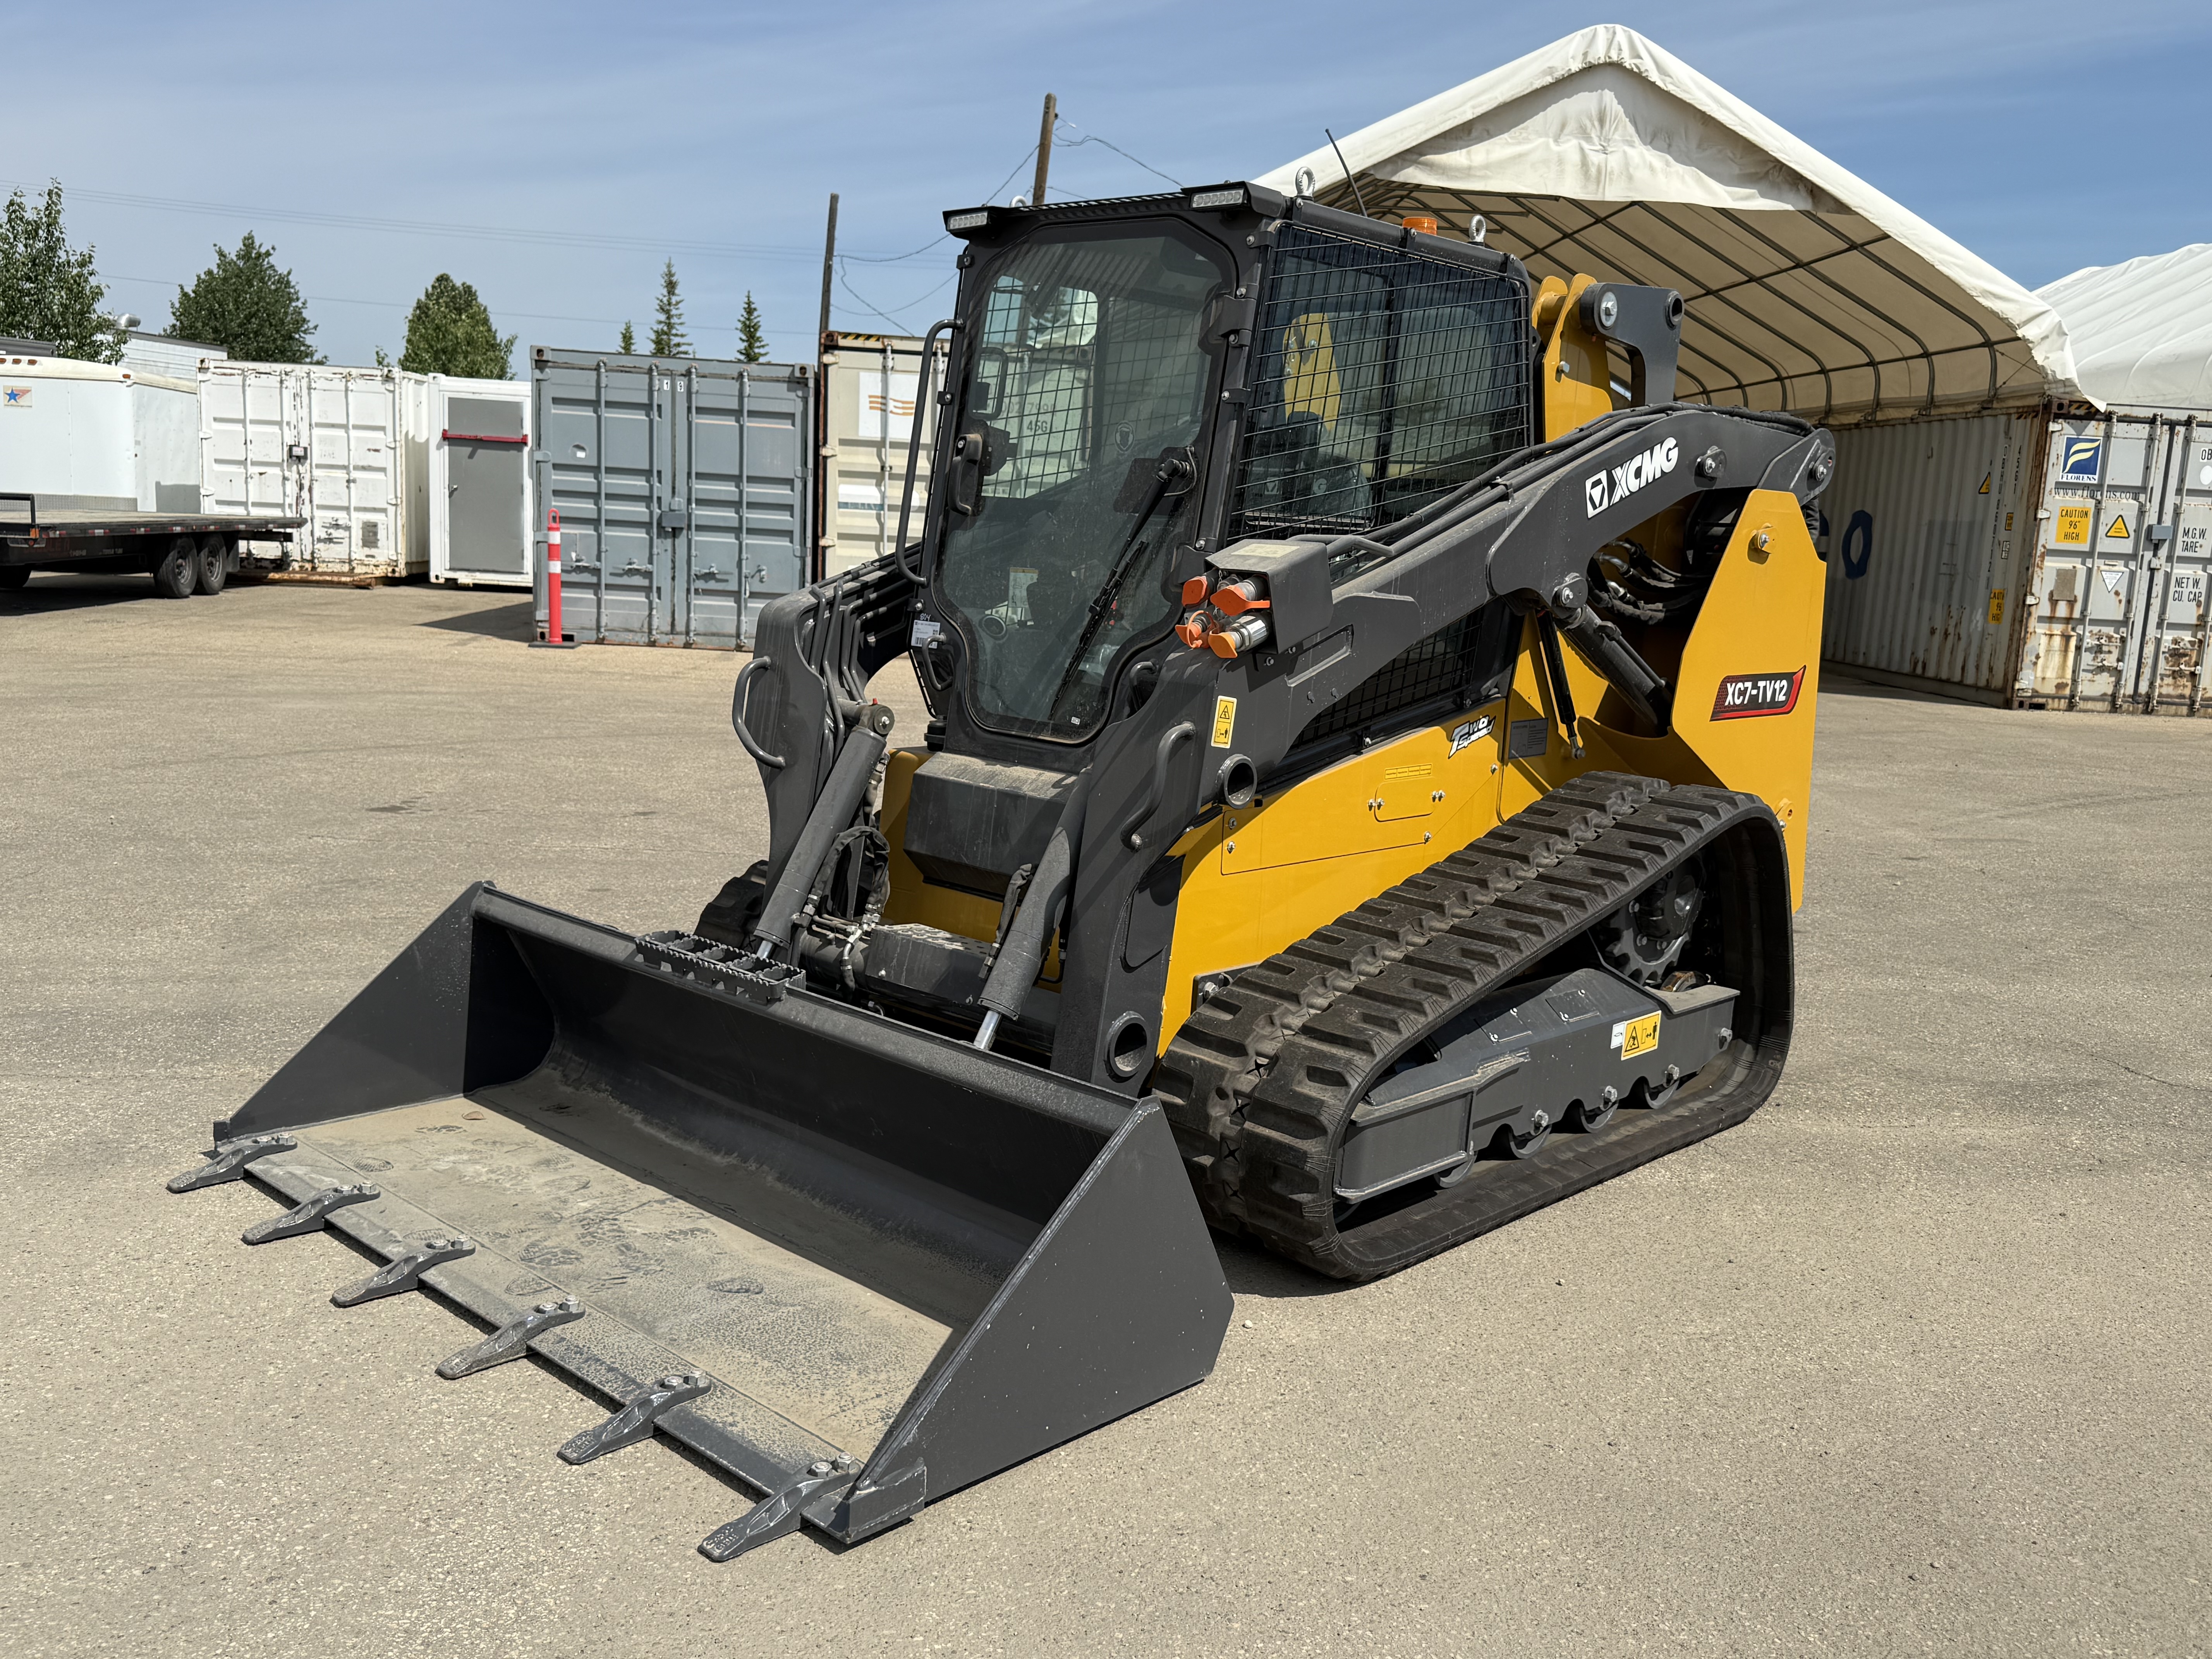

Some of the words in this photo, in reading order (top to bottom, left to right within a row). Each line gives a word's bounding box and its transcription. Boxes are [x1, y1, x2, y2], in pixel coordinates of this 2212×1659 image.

[1027, 420, 1051, 432] 45G
[1609, 437, 1678, 506] XCMG
[2054, 485, 2140, 501] www.florns.com
[2061, 509, 2088, 519] CAUTION
[2064, 531, 2080, 541] HIGH
[2182, 527, 2207, 540] M.G.W.
[2181, 541, 2199, 553] TARE
[2174, 577, 2190, 589] NET
[2192, 578, 2200, 589] W.
[2172, 590, 2184, 603] CU.
[1724, 679, 1788, 706] XC7-TV12
